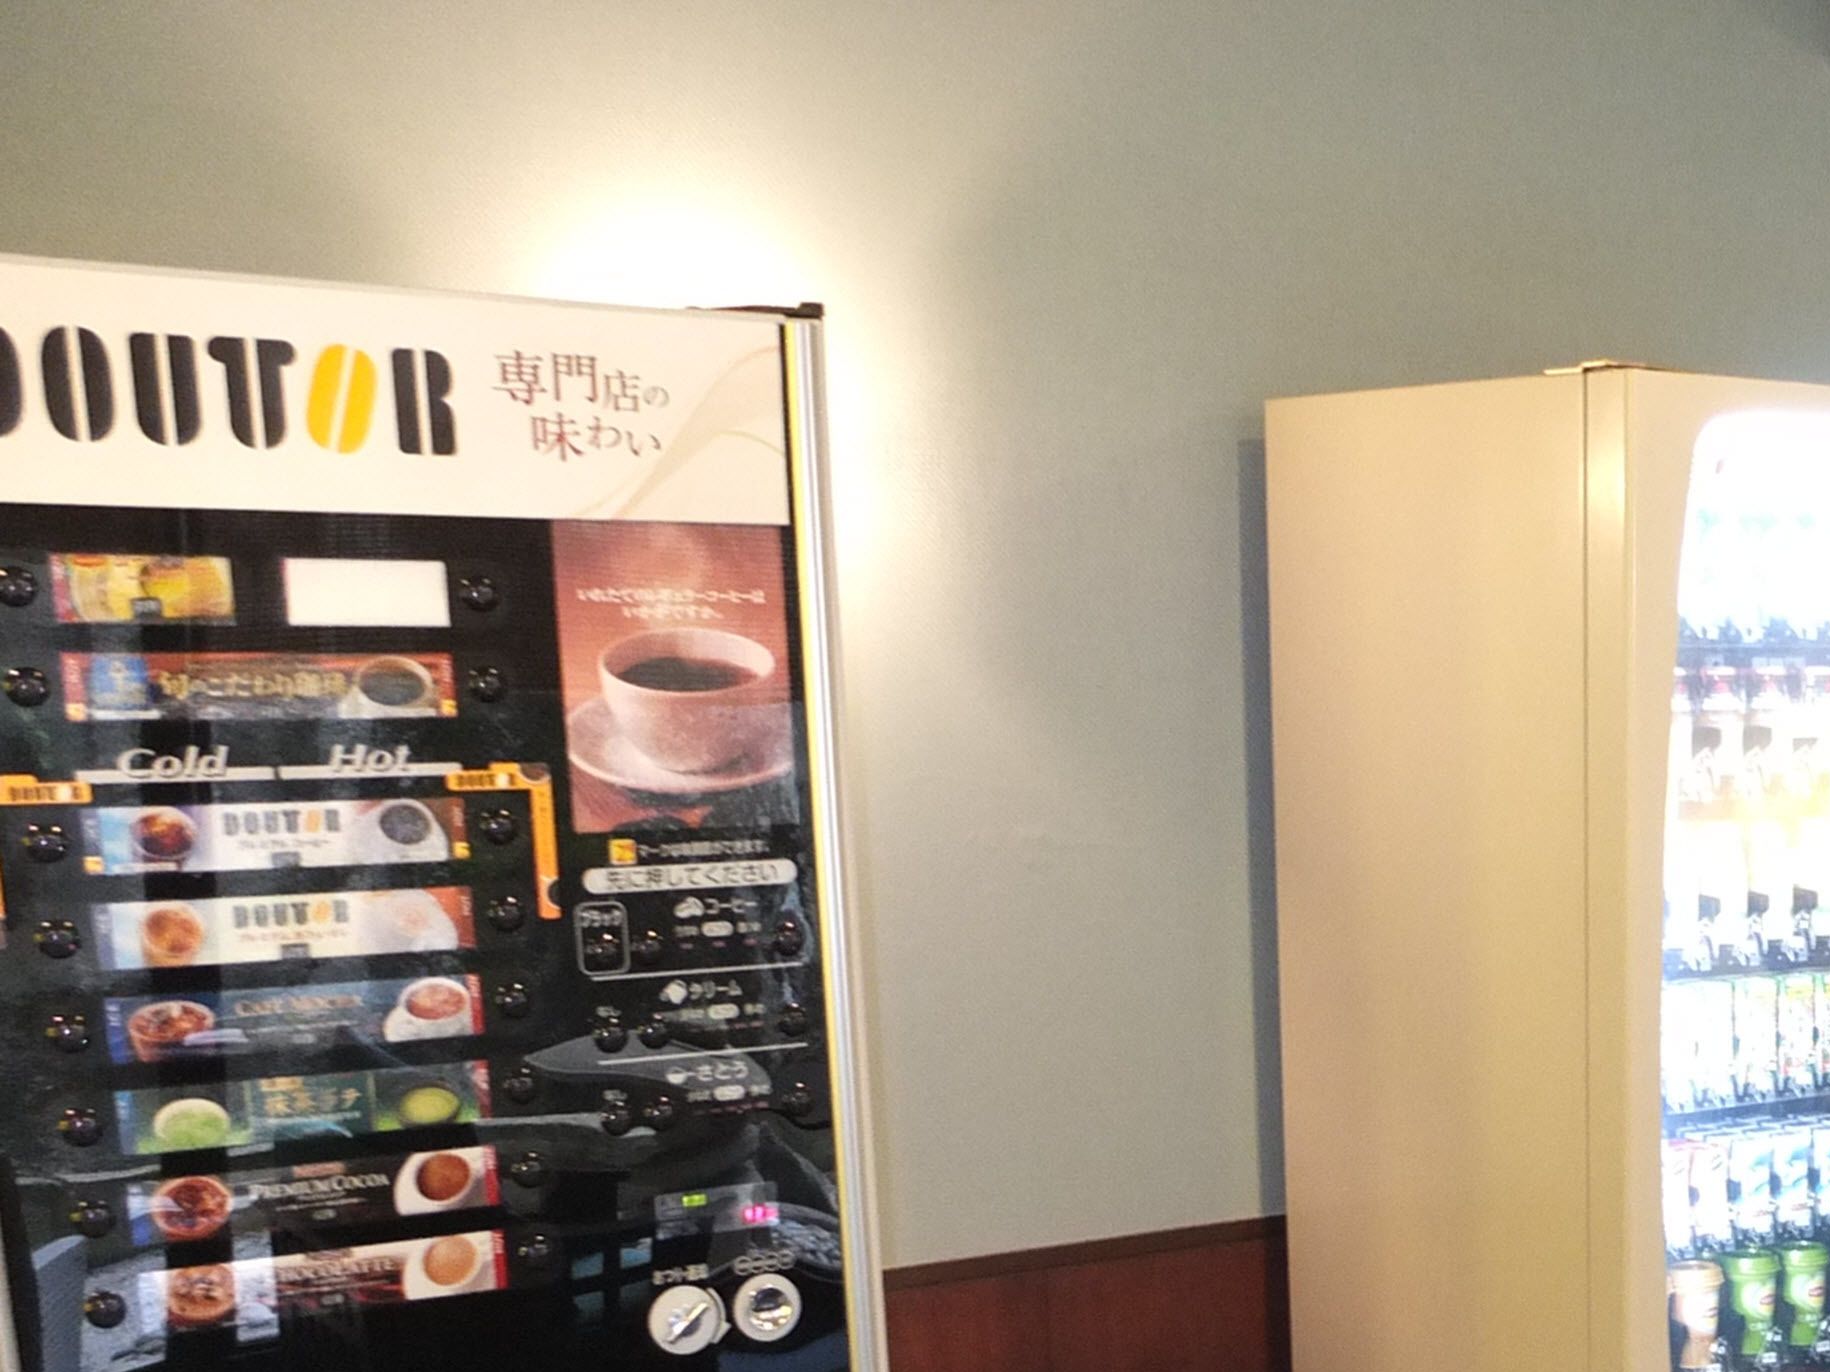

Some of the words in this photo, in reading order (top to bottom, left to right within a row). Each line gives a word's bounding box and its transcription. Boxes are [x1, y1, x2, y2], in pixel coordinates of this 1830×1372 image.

[492, 350, 670, 412] 専門店の
[531, 413, 663, 461] 味わい
[117, 745, 230, 779] Cold
[329, 744, 411, 774] Hot
[222, 809, 340, 837] DOUTOR
[607, 864, 778, 890] 先に押してください
[232, 899, 350, 928] DOUTOR
